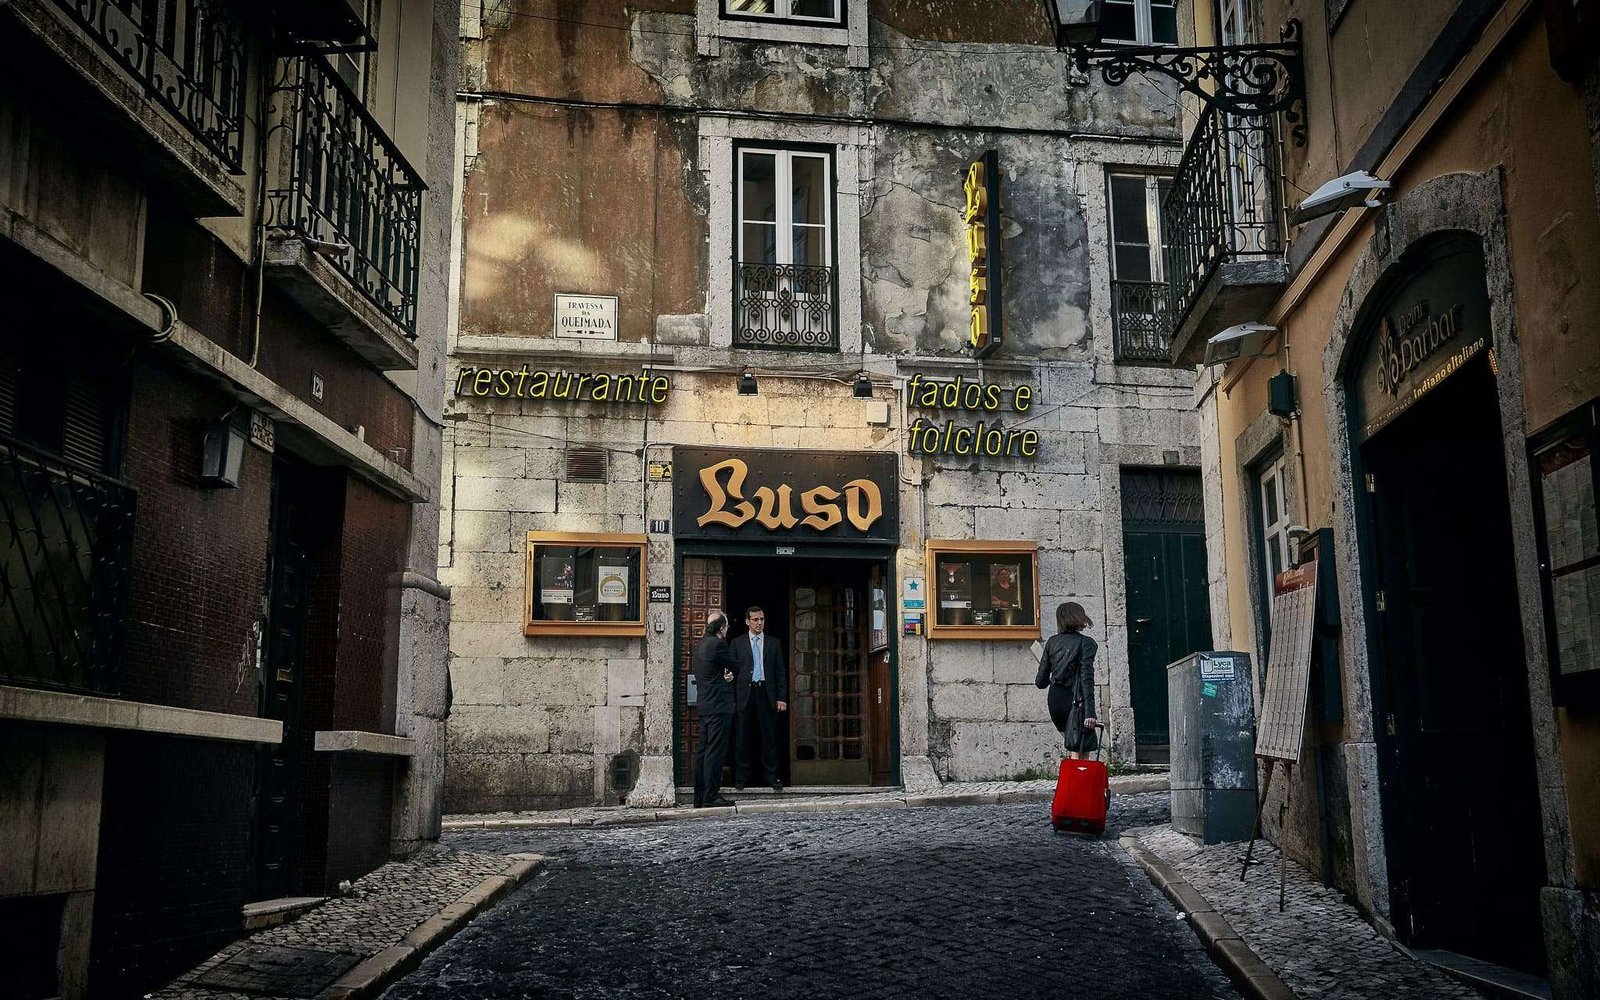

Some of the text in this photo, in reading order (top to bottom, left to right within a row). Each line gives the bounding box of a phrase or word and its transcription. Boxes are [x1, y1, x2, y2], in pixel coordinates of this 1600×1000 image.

[561, 316, 612, 329] QUEIMADA
[568, 302, 604, 310] TRAVESSA
[1400, 304, 1457, 373] Darbar
[455, 364, 669, 403] restaurante
[1413, 368, 1446, 399] Indiano
[1451, 337, 1485, 369] Italiano
[909, 374, 1032, 411] fados e
[910, 418, 1039, 456] folclore
[697, 459, 883, 532] Luso
[655, 521, 665, 532] 10
